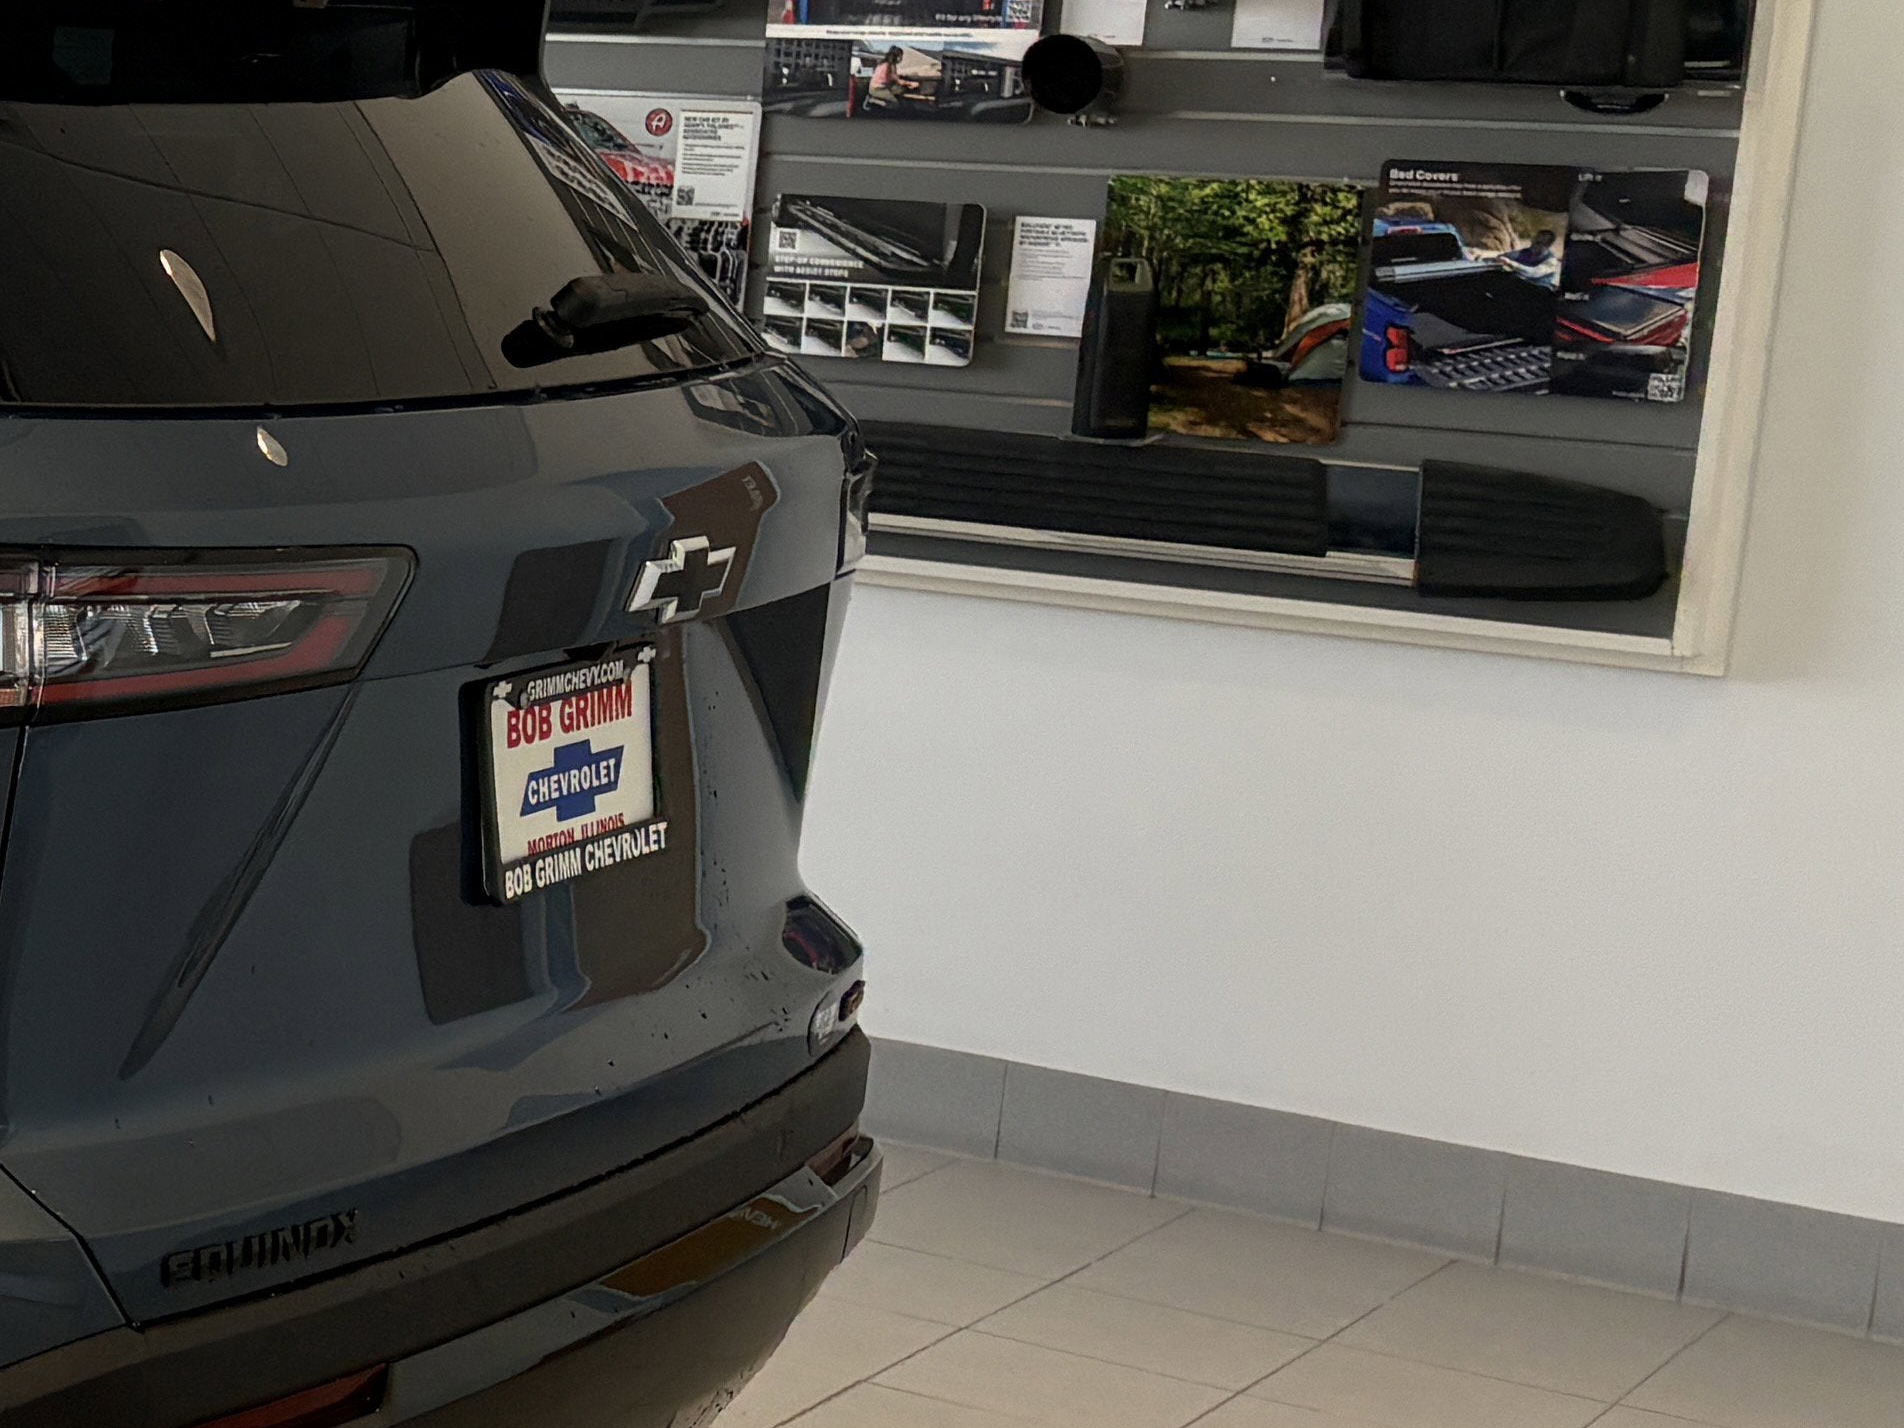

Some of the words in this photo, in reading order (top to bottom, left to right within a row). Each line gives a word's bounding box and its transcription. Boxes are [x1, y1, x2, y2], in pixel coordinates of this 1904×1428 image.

[1416, 170, 1459, 182] Covers
[527, 659, 625, 701] GRIMMCHEVY.COM
[507, 704, 552, 749] BOB
[559, 679, 633, 734] GRIMM
[528, 758, 617, 805] CHEVROLET
[505, 863, 533, 899] BOB
[535, 847, 583, 888] GRIMM
[584, 821, 668, 872] CHEVROLET
[160, 1208, 358, 1288] EQUINOX
